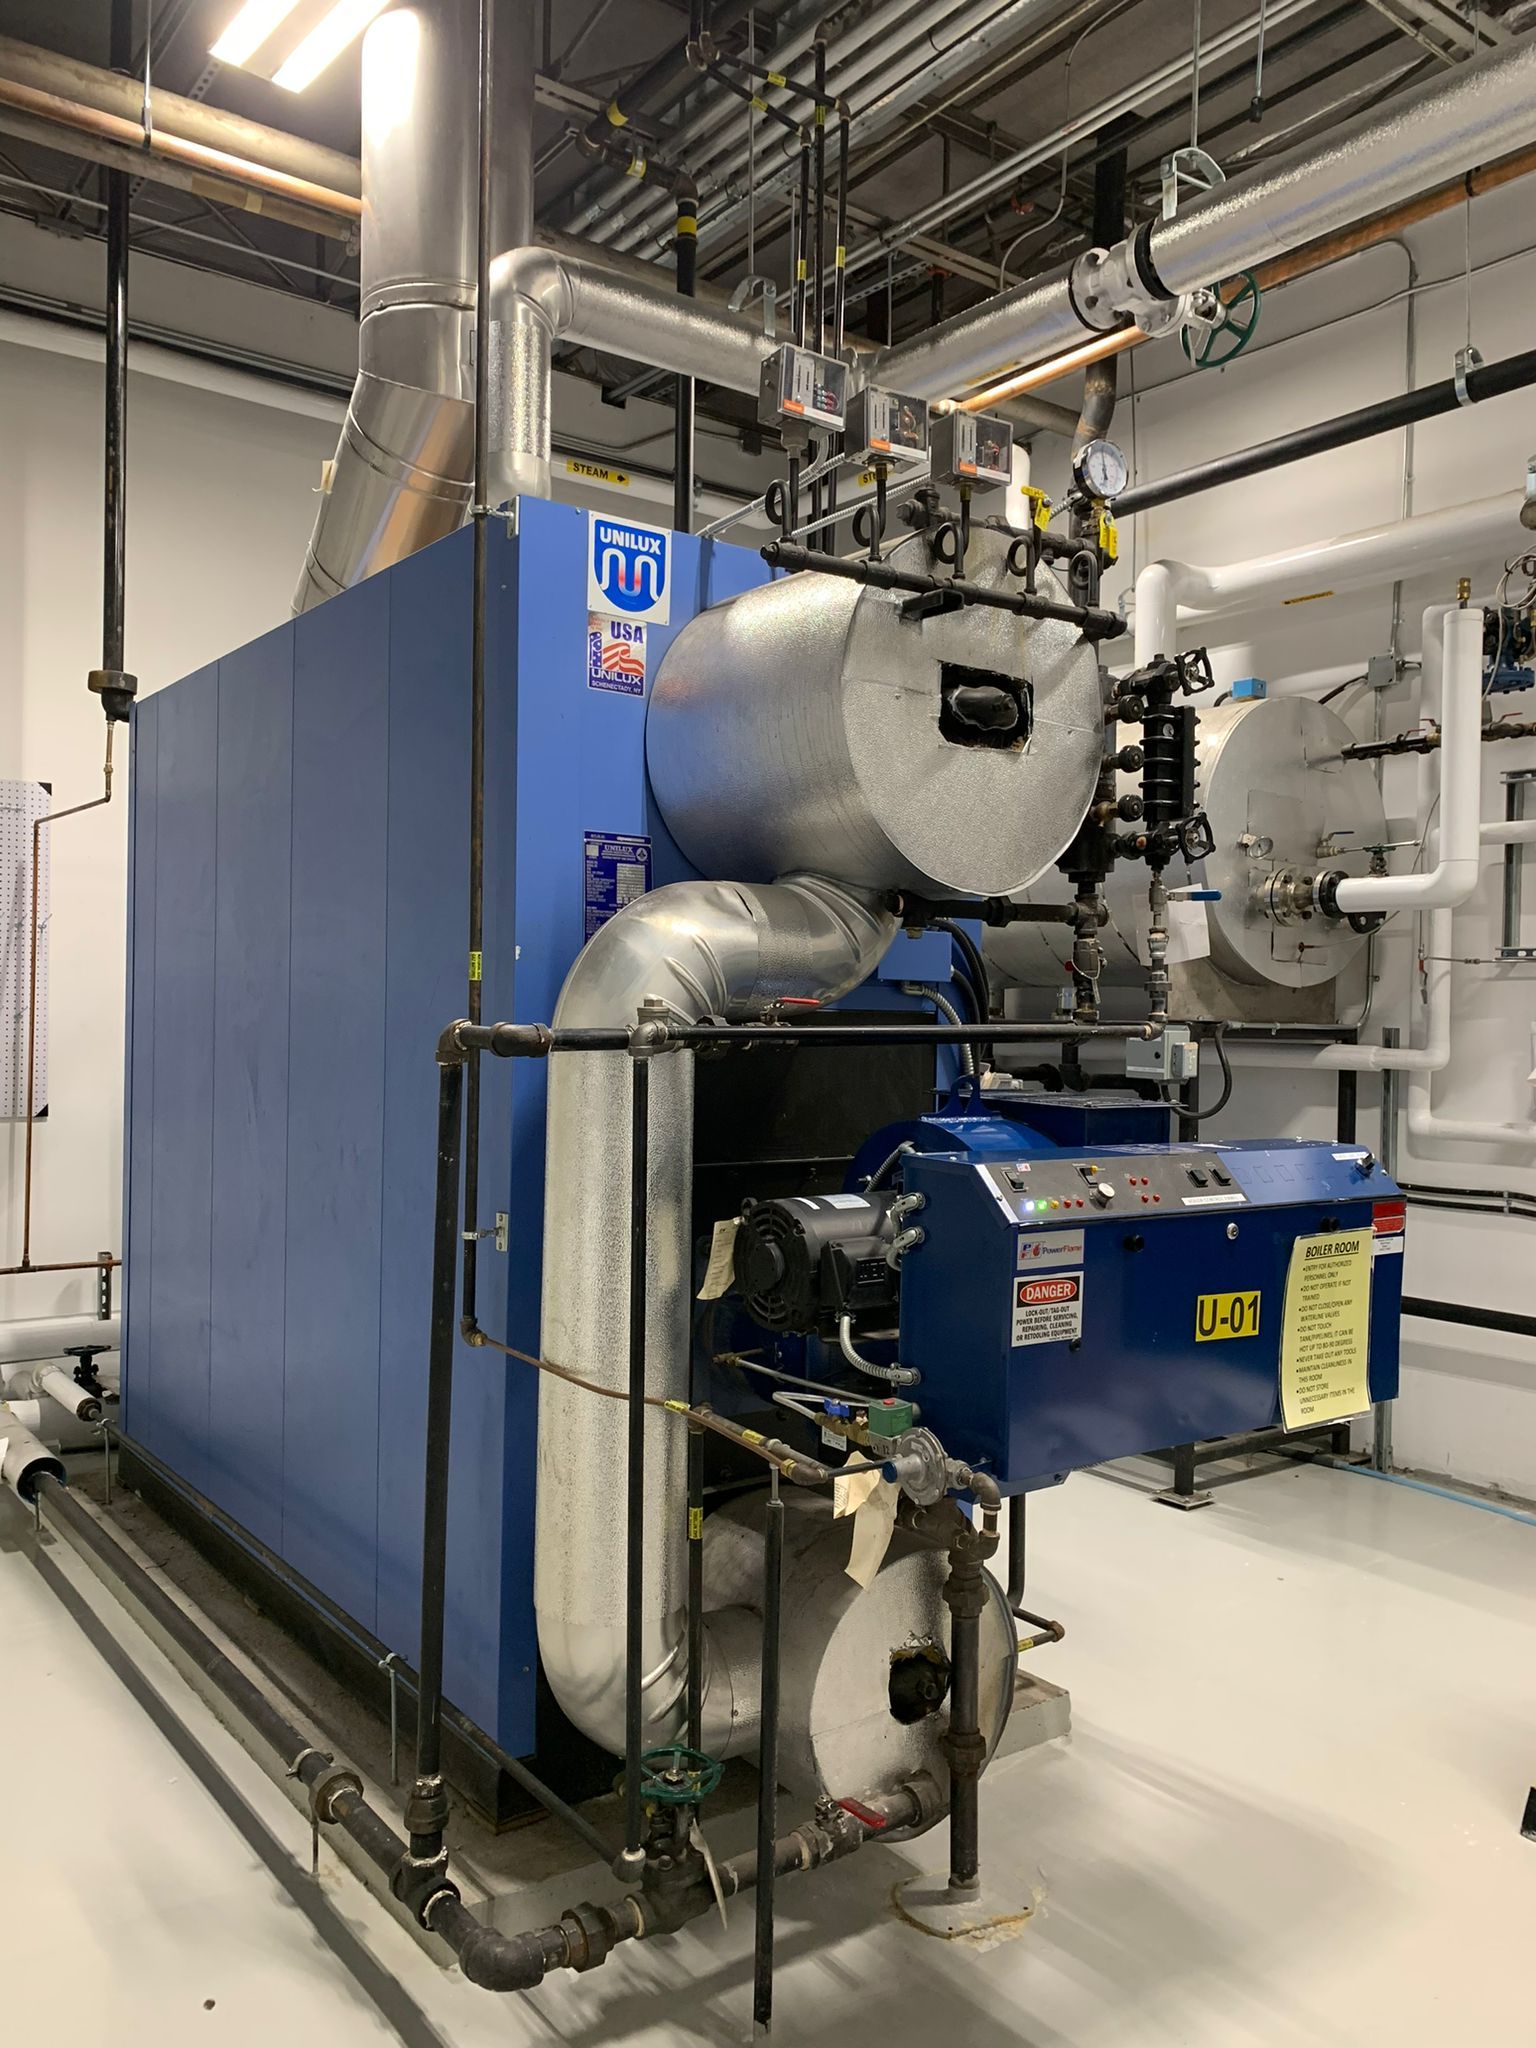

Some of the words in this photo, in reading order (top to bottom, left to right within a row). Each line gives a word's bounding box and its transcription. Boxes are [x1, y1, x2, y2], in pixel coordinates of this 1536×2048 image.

[573, 463, 608, 479] STEAM
[600, 527, 661, 555] UNILUX
[611, 621, 643, 643] USA
[592, 668, 640, 685] UNILUX
[1042, 1245, 1082, 1254] PowerFlame
[1306, 1244, 1332, 1257] BOILER
[1334, 1240, 1359, 1253] ROOM
[1327, 1260, 1351, 1268] AUTHORIZED
[1304, 1273, 1326, 1281] PERSONNEL
[1320, 1281, 1337, 1289] OPERATE
[1027, 1283, 1072, 1300] DANGER
[1302, 1293, 1319, 1301] TRAINED
[1034, 1315, 1052, 1323] BEFORE
[1053, 1313, 1078, 1321] SERVICING,
[1199, 1295, 1258, 1336] U-01
[1301, 1313, 1324, 1322] WATERLINE
[1049, 1321, 1072, 1329] CLEANING
[1024, 1332, 1050, 1340] RETOOLING
[1051, 1328, 1077, 1337] EQUIPMENT
[1299, 1354, 1312, 1362] NEVER
[1344, 1347, 1356, 1355] TOOLS
[1299, 1364, 1320, 1373] MAINTAIN
[1321, 1360, 1346, 1369] CLEANLINESS
[1309, 1373, 1322, 1381] ROOM
[1300, 1393, 1328, 1404] UNNECESSARY
[1301, 1406, 1314, 1414] ROOM
